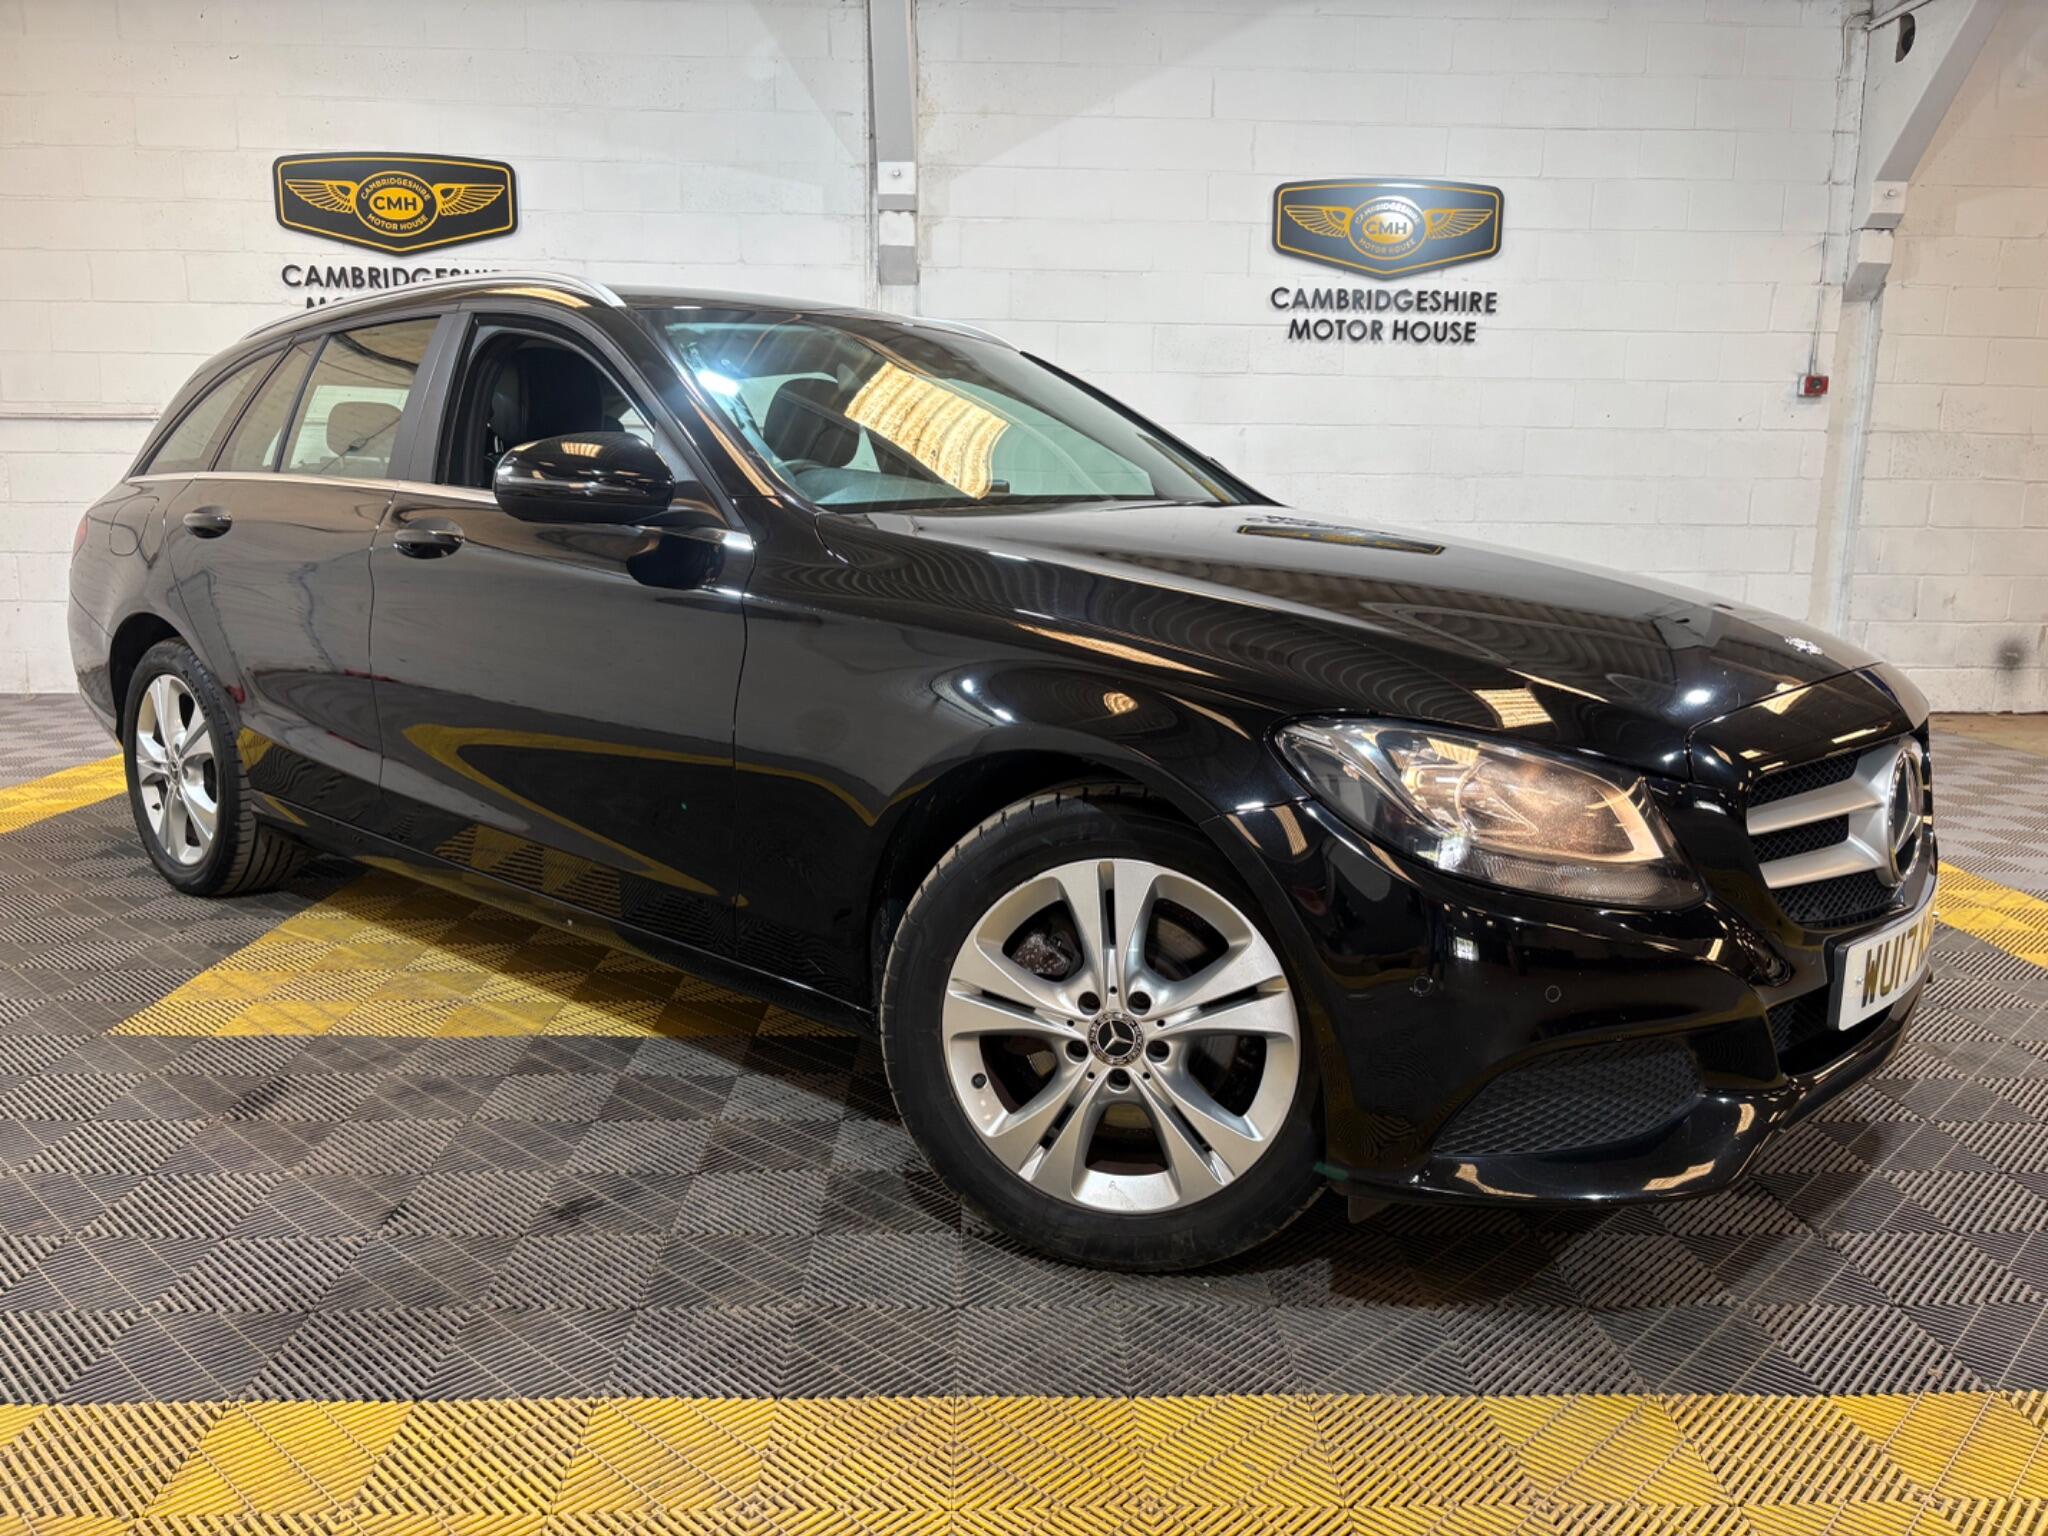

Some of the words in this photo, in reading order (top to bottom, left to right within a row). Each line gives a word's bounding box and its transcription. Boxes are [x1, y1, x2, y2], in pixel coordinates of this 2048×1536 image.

[360, 177, 432, 201] CAMBRIDGESHIRE
[373, 195, 418, 212] CMH
[367, 212, 398, 231] MOTOR
[399, 213, 429, 231] HOUSE
[1366, 221, 1409, 236] CMH
[1271, 287, 1498, 314] CAMBRIDGESHIRE
[1288, 319, 1384, 343] MOTOR
[1392, 320, 1477, 344] HOUSE
[1861, 922, 1919, 1009] WU17
